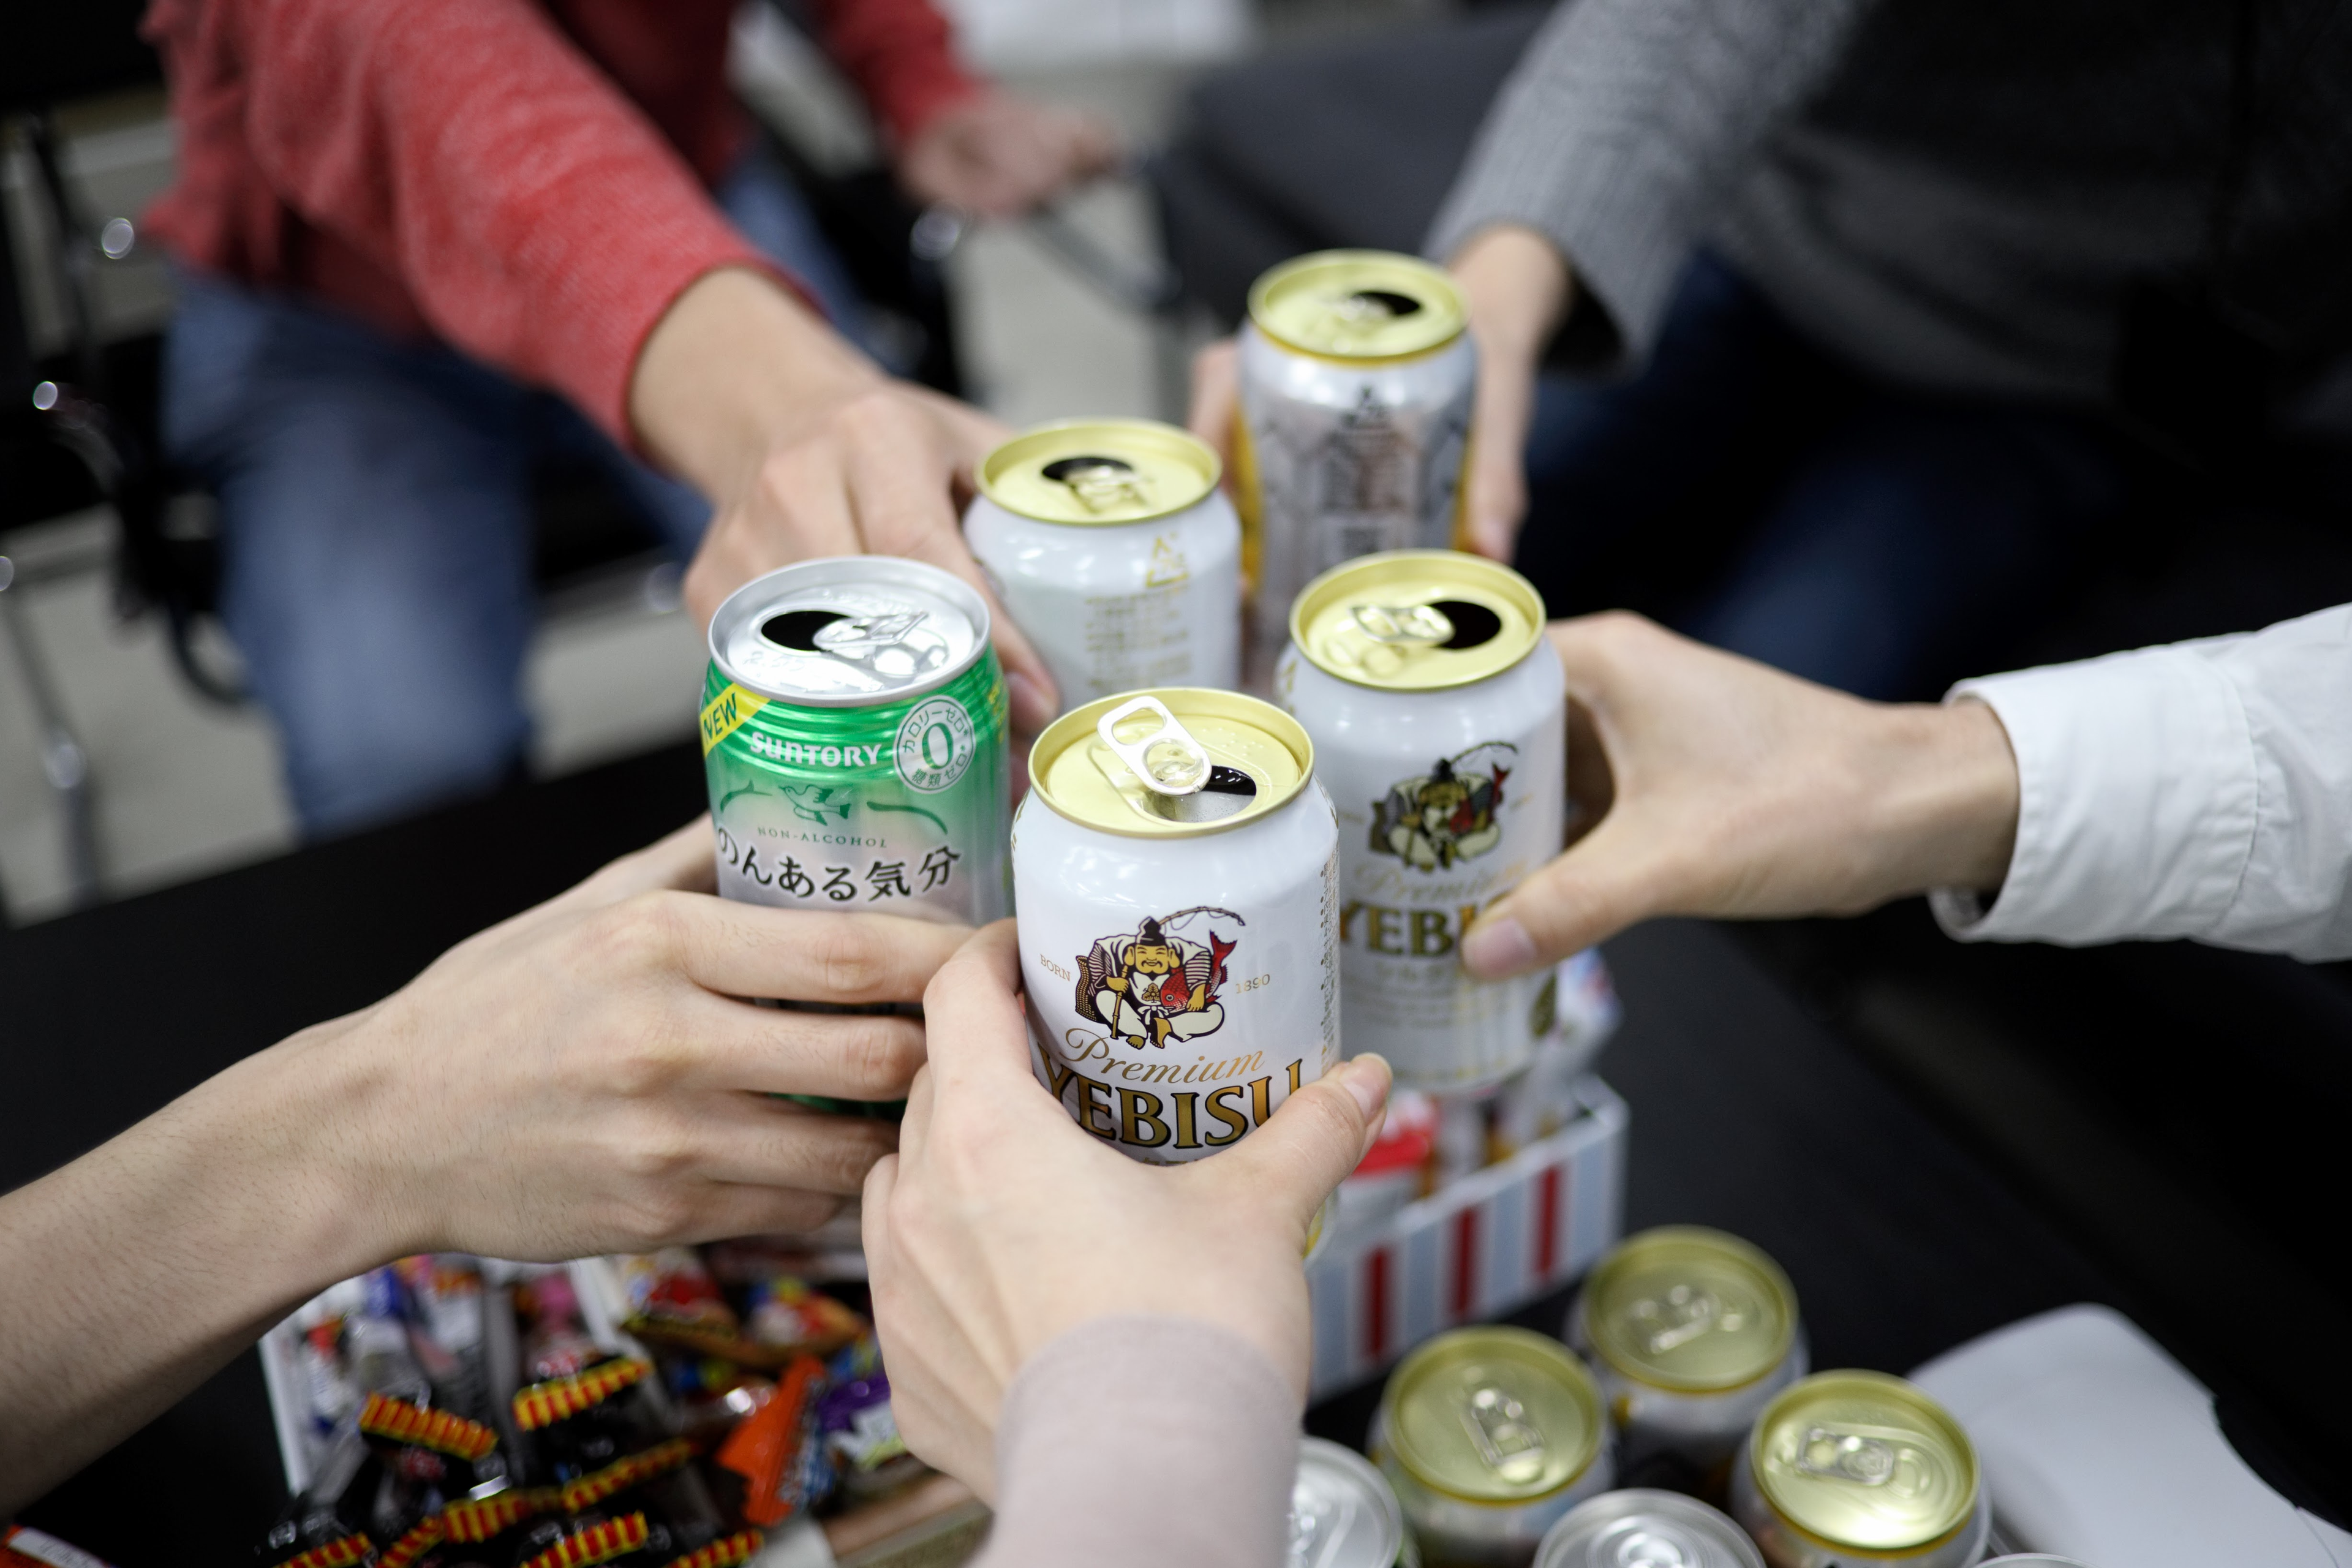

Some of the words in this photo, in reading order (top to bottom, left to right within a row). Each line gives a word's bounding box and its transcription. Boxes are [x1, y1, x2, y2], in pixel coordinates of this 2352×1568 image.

[703, 692, 736, 745] NEW
[750, 731, 882, 767] SUNTORY
[922, 723, 954, 770] 0
[757, 826, 888, 849] NON-ALCOHOL
[718, 826, 961, 902] のんある気分
[1041, 954, 1071, 982] BORN
[1235, 974, 1270, 994] 1890
[1058, 1028, 1265, 1084] Premium
